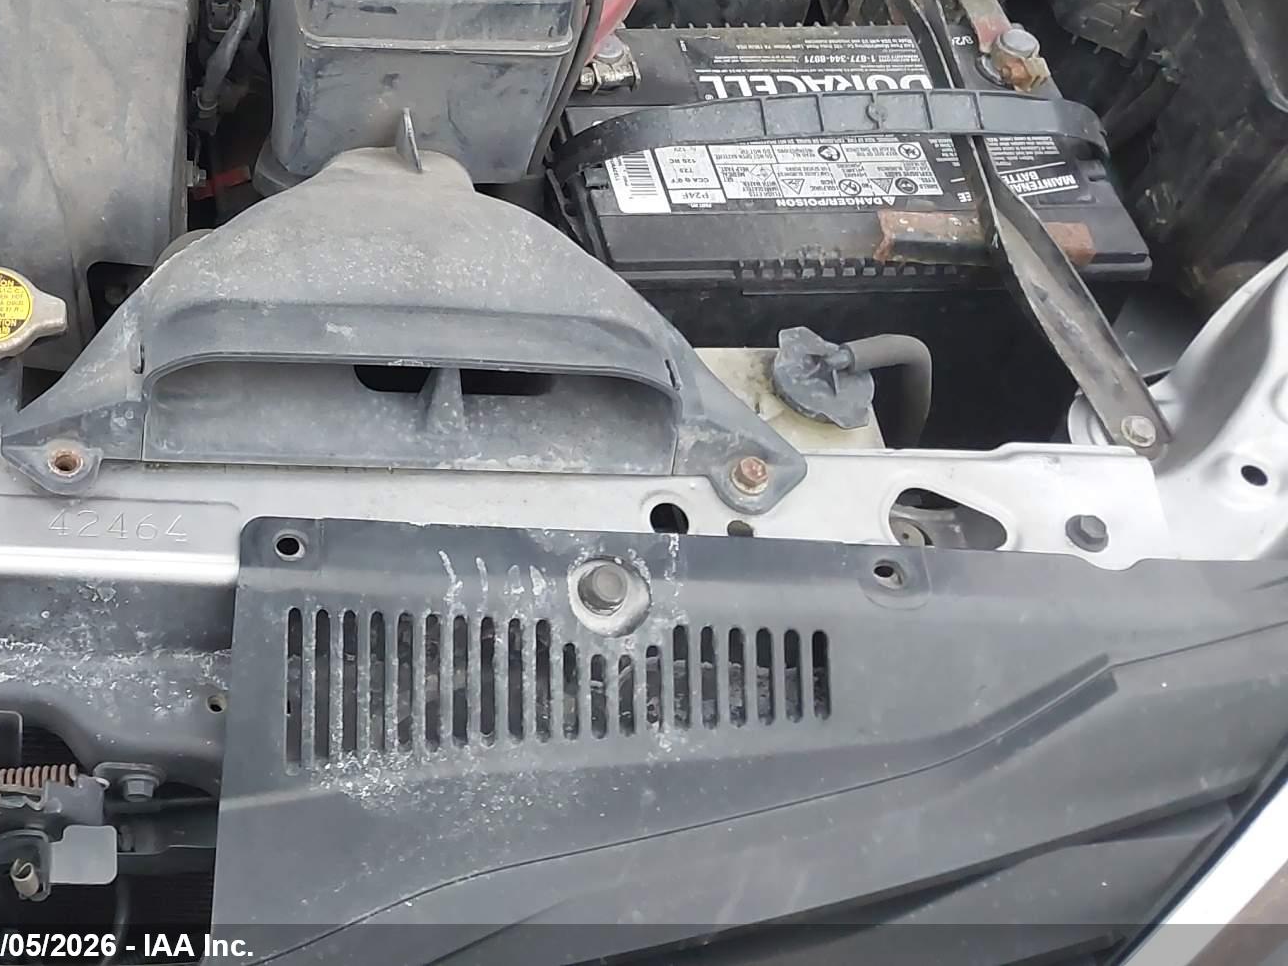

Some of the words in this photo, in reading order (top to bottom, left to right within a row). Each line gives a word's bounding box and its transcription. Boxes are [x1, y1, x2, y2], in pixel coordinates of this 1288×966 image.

[698, 74, 934, 100] DURACELL
[775, 196, 884, 207] DANGER/POISON
[956, 191, 972, 204] EE
[47, 508, 188, 542] 42464
